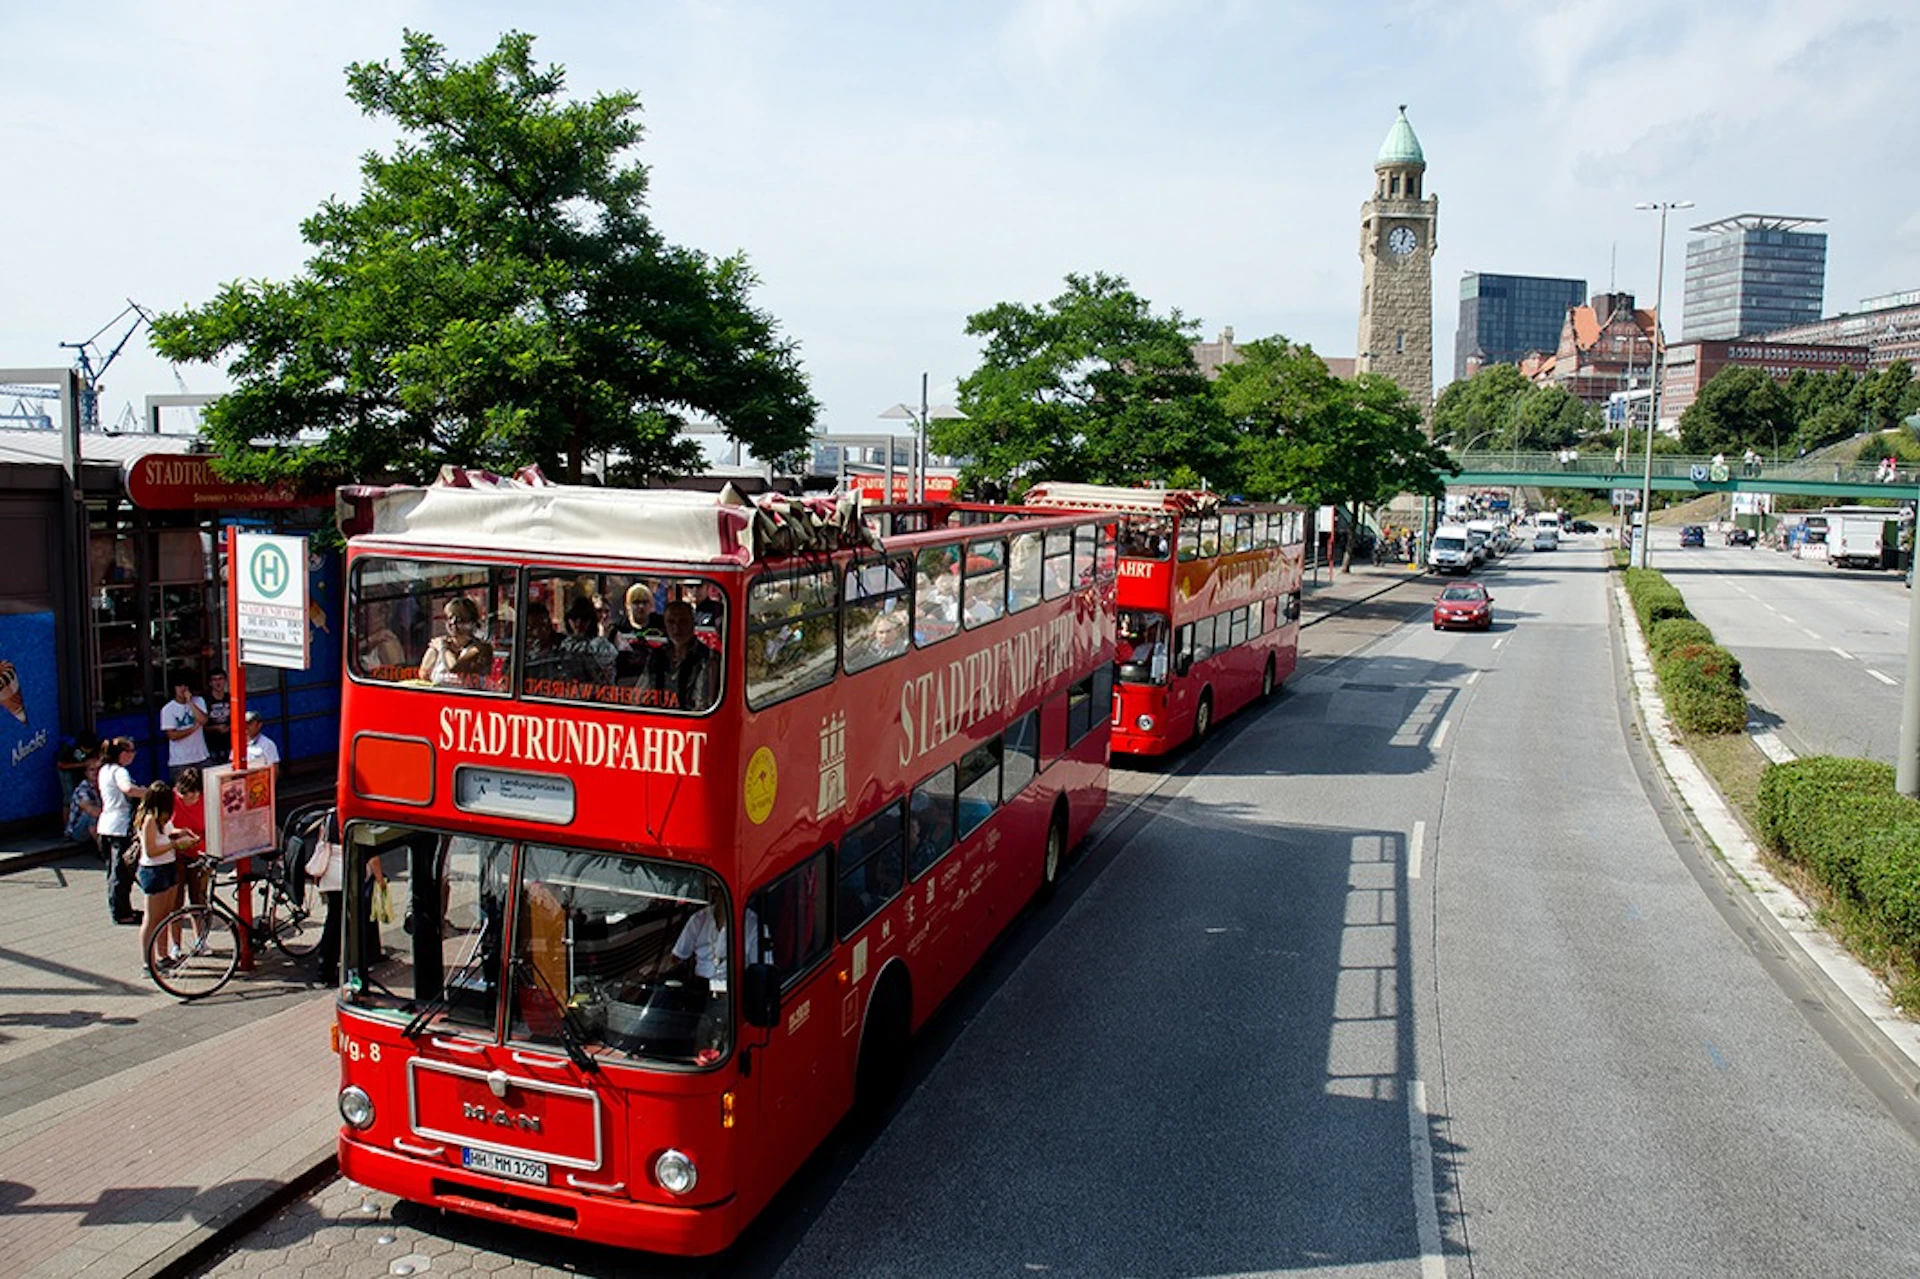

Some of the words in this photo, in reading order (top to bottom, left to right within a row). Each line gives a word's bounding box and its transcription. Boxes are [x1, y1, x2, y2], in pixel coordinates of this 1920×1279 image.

[261, 554, 279, 587] H
[1117, 561, 1155, 579] AHRT
[900, 612, 1075, 767] STADTRUNDFAHRT
[439, 706, 707, 777] STADTRUNDFAHRT
[369, 1042, 381, 1063] 8
[513, 1161, 545, 1179] 1295
